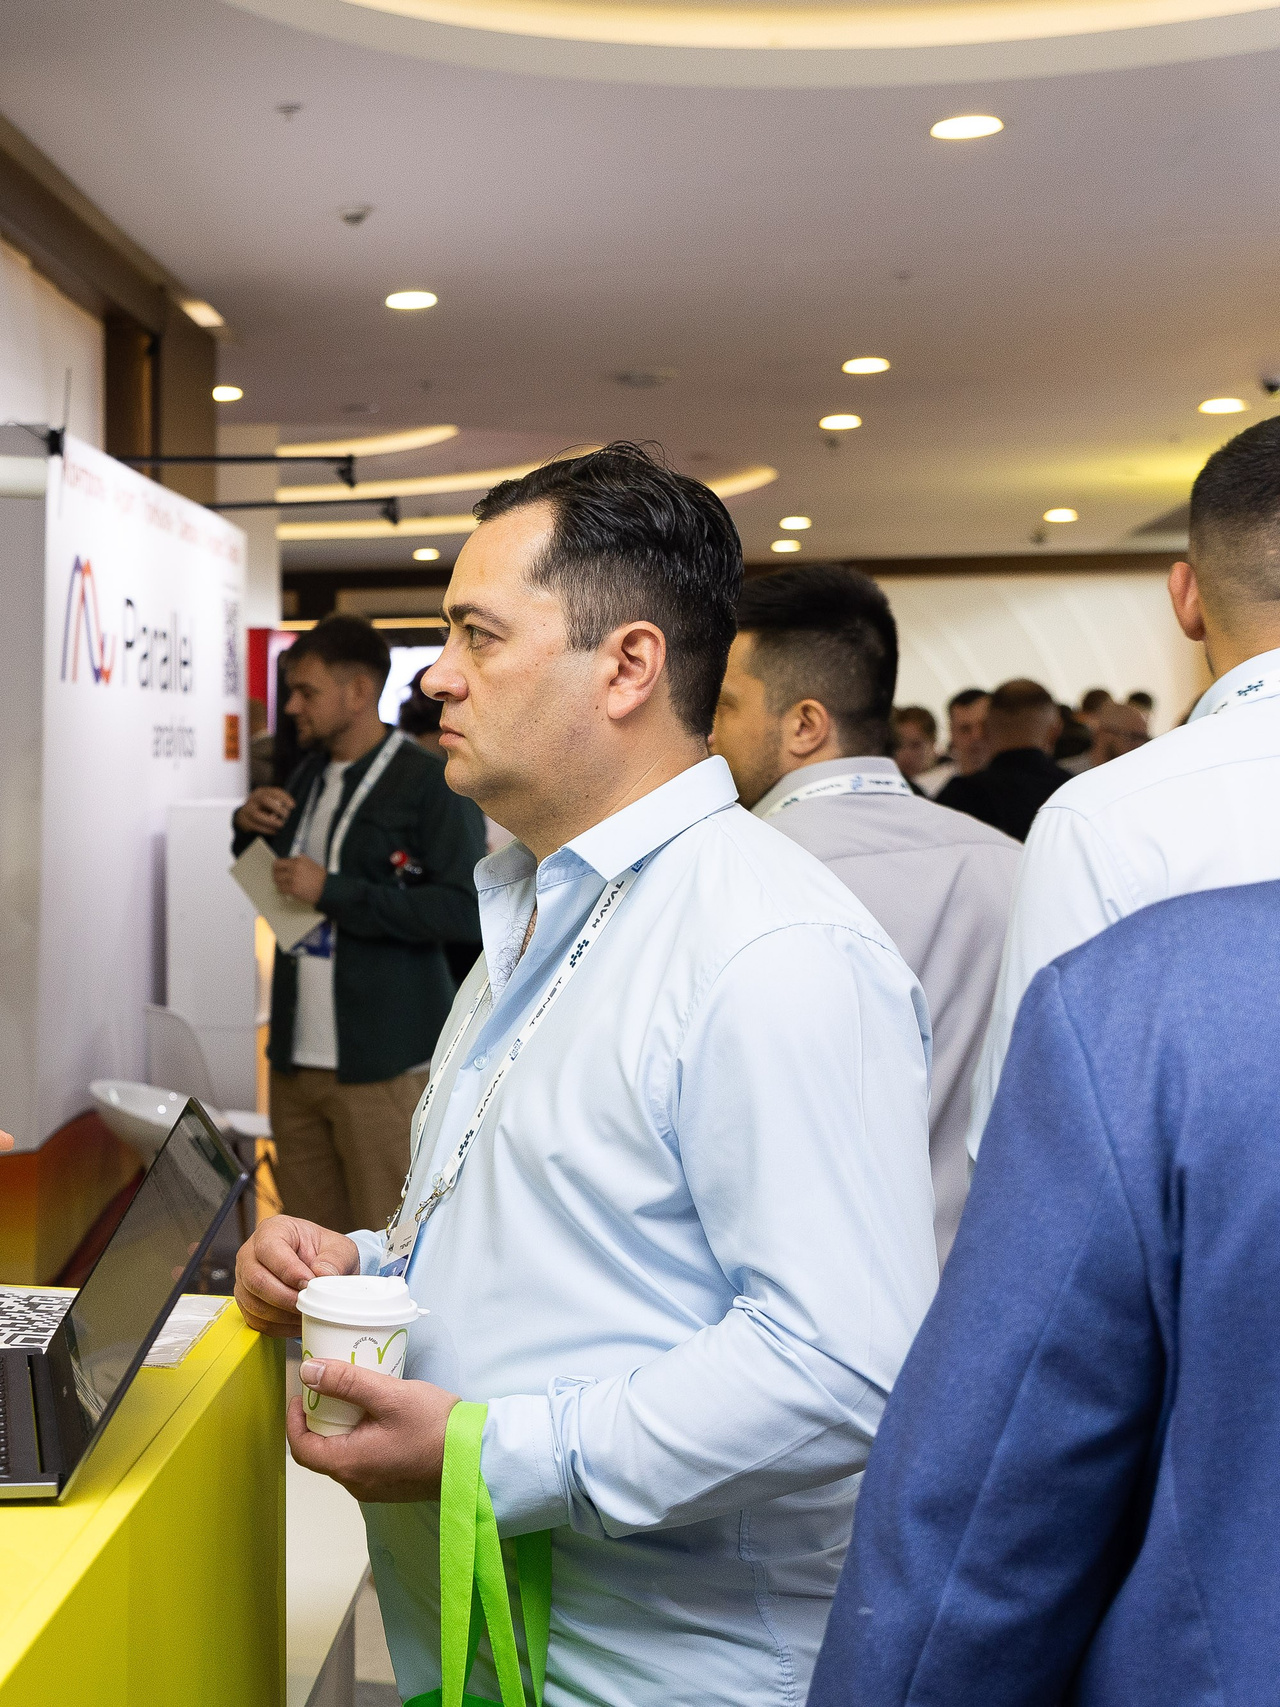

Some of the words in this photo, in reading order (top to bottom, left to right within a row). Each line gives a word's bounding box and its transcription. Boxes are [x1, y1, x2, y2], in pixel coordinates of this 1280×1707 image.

[591, 880, 625, 929] HAVAL
[529, 976, 563, 1027] TENET
[477, 1070, 505, 1119] HAVAL
